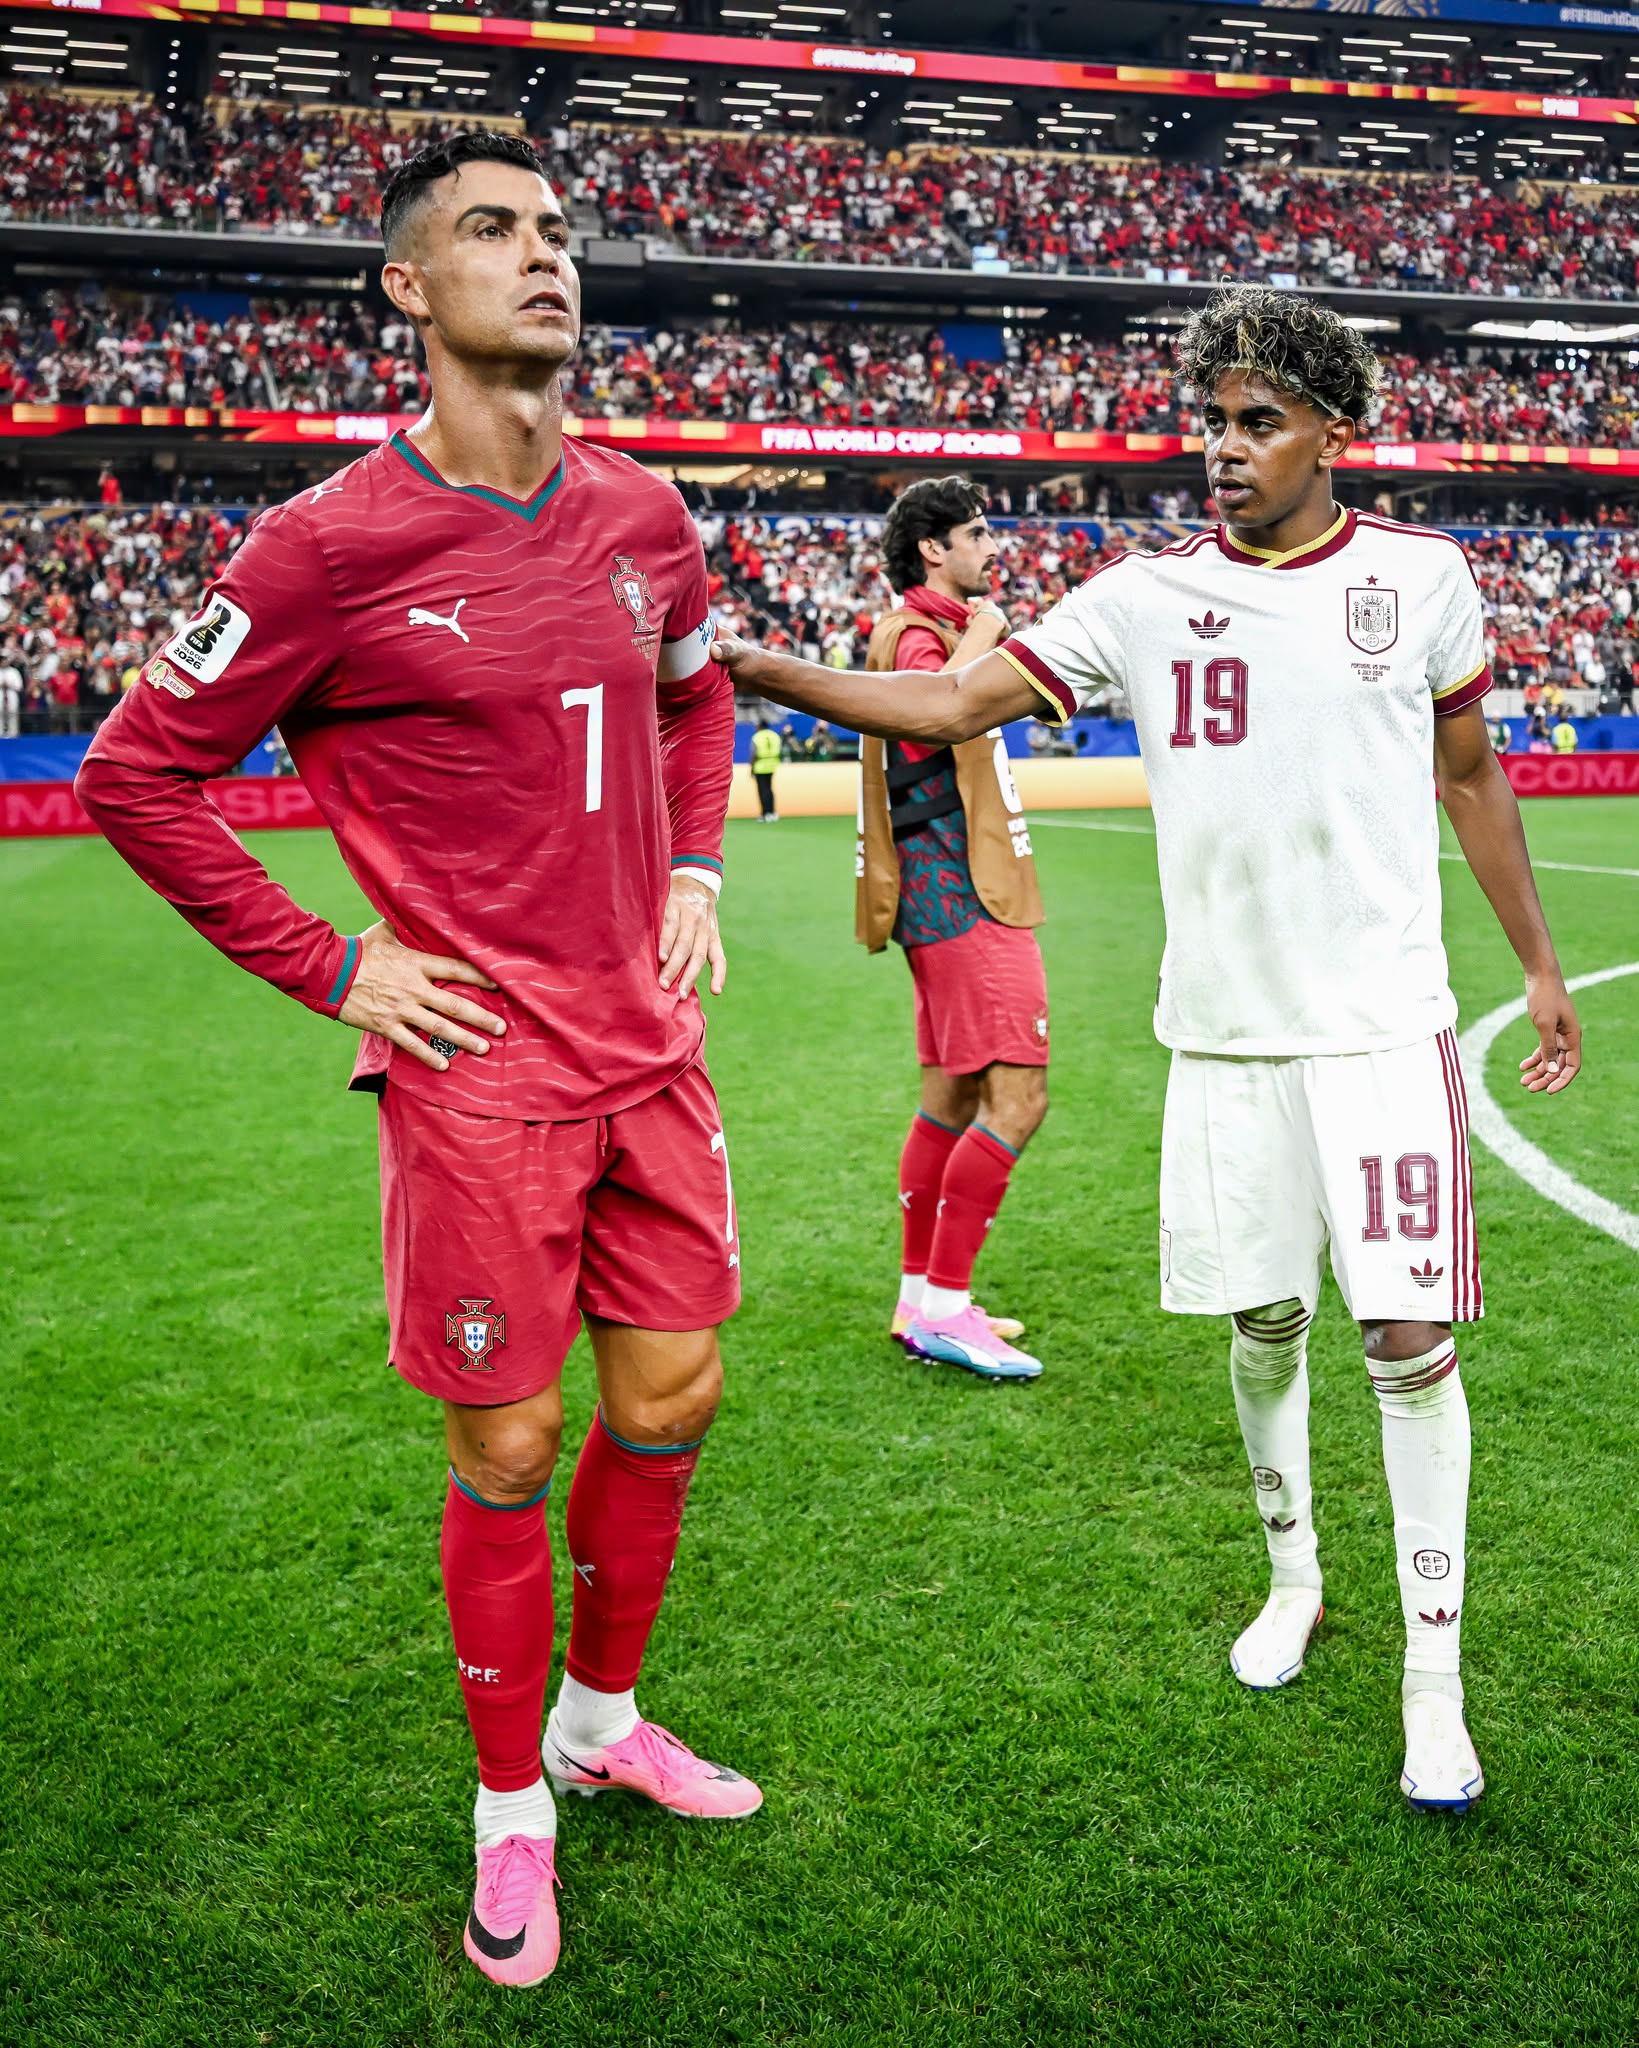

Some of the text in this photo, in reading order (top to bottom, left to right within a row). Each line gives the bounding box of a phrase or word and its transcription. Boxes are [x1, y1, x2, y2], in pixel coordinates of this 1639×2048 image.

[761, 427, 812, 449] FIFA
[812, 429, 895, 452] WORLD
[896, 431, 942, 453] CUP
[189, 635, 204, 649] FIFA
[173, 647, 202, 669] 2026
[194, 653, 207, 663] CUP
[166, 677, 188, 696] LEGACY
[1170, 657, 1249, 748] 19
[1360, 1152, 1440, 1242] 19
